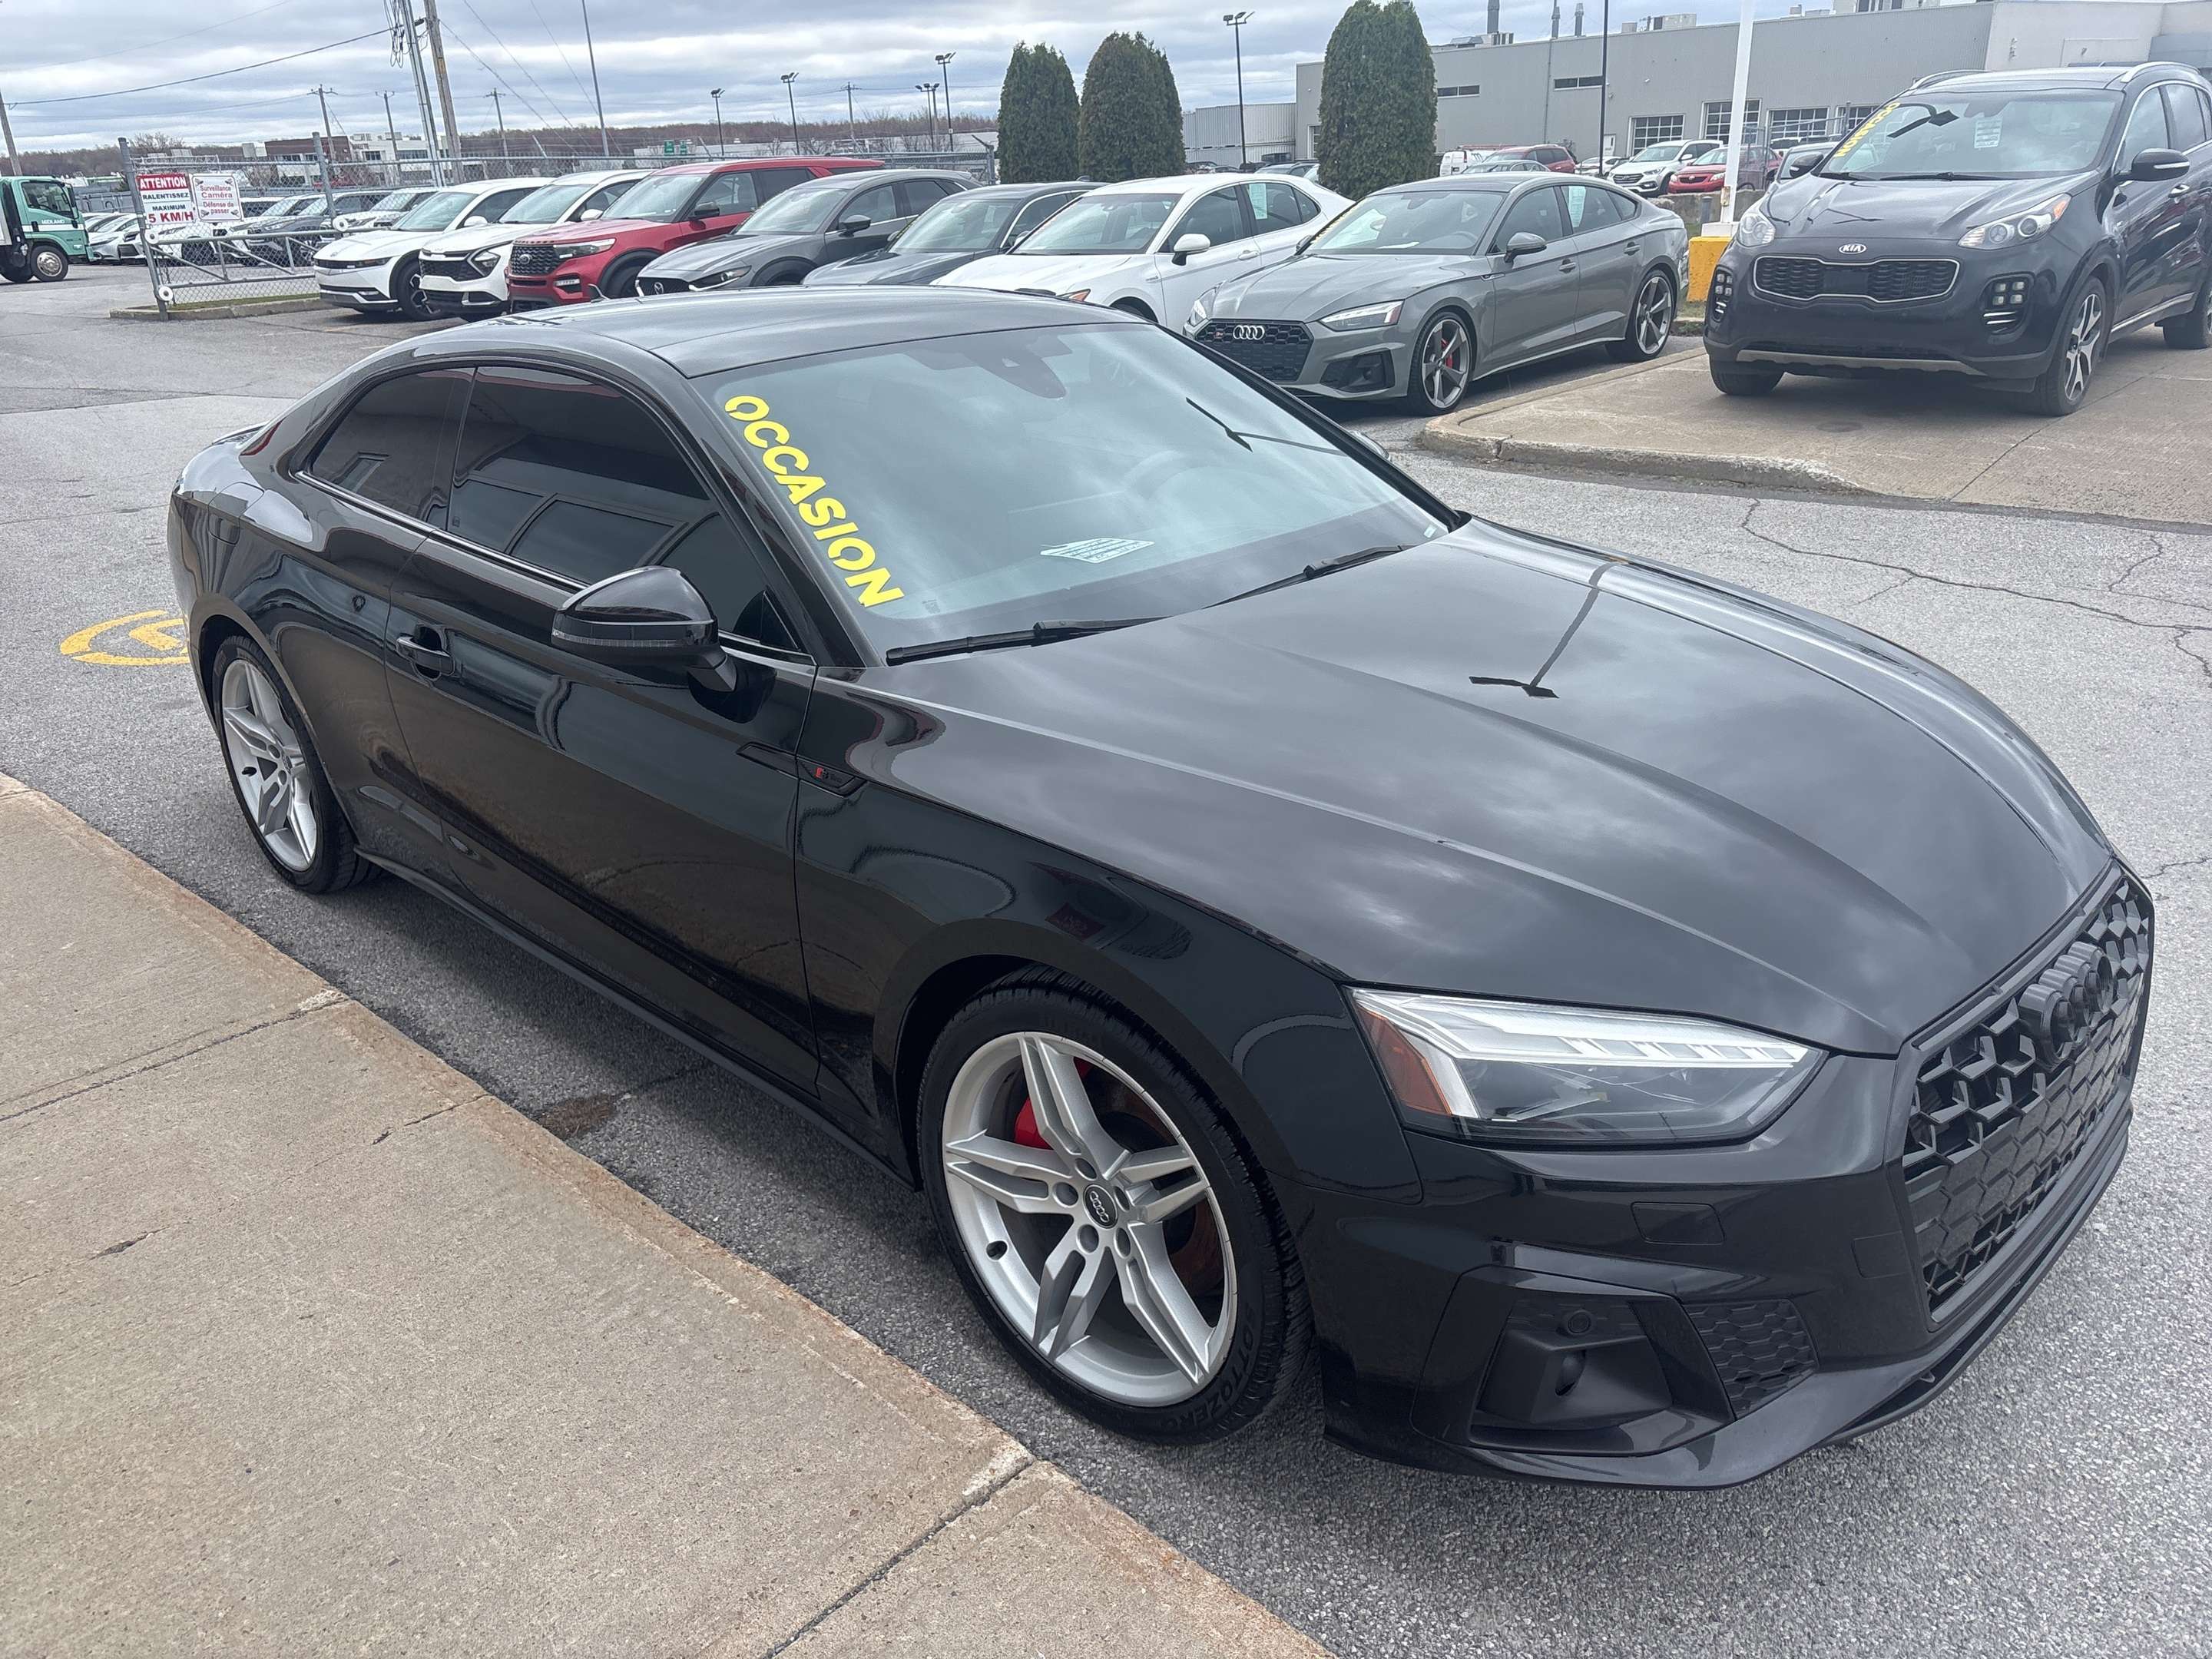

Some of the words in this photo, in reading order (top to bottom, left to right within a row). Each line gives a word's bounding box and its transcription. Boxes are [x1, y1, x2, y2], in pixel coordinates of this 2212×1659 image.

[1833, 102, 1901, 157] OCCASION
[139, 176, 187, 189] ATTENTION
[148, 214, 157, 223] 5
[160, 211, 194, 223] KM/H
[724, 396, 905, 608] OCCASION
